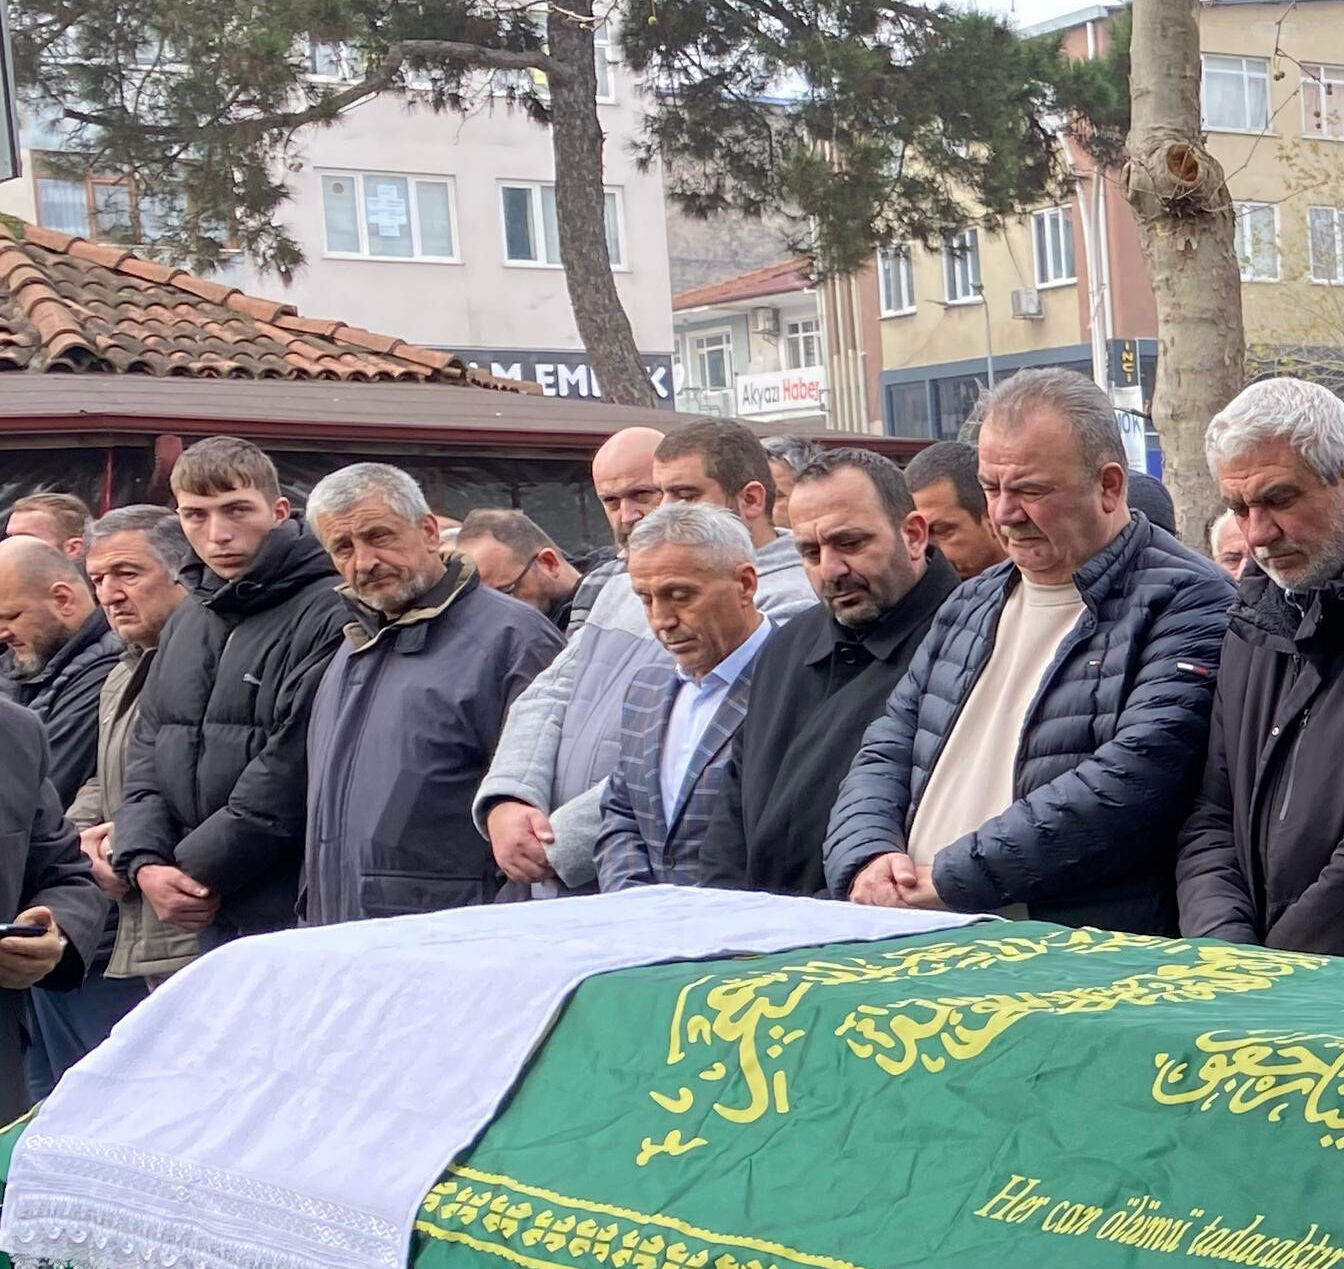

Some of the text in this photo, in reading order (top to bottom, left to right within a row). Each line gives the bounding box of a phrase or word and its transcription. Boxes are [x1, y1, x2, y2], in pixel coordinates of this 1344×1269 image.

[972, 1173, 1050, 1225] Her
[1041, 1197, 1103, 1237] can
[1096, 1194, 1206, 1254] ölümü
